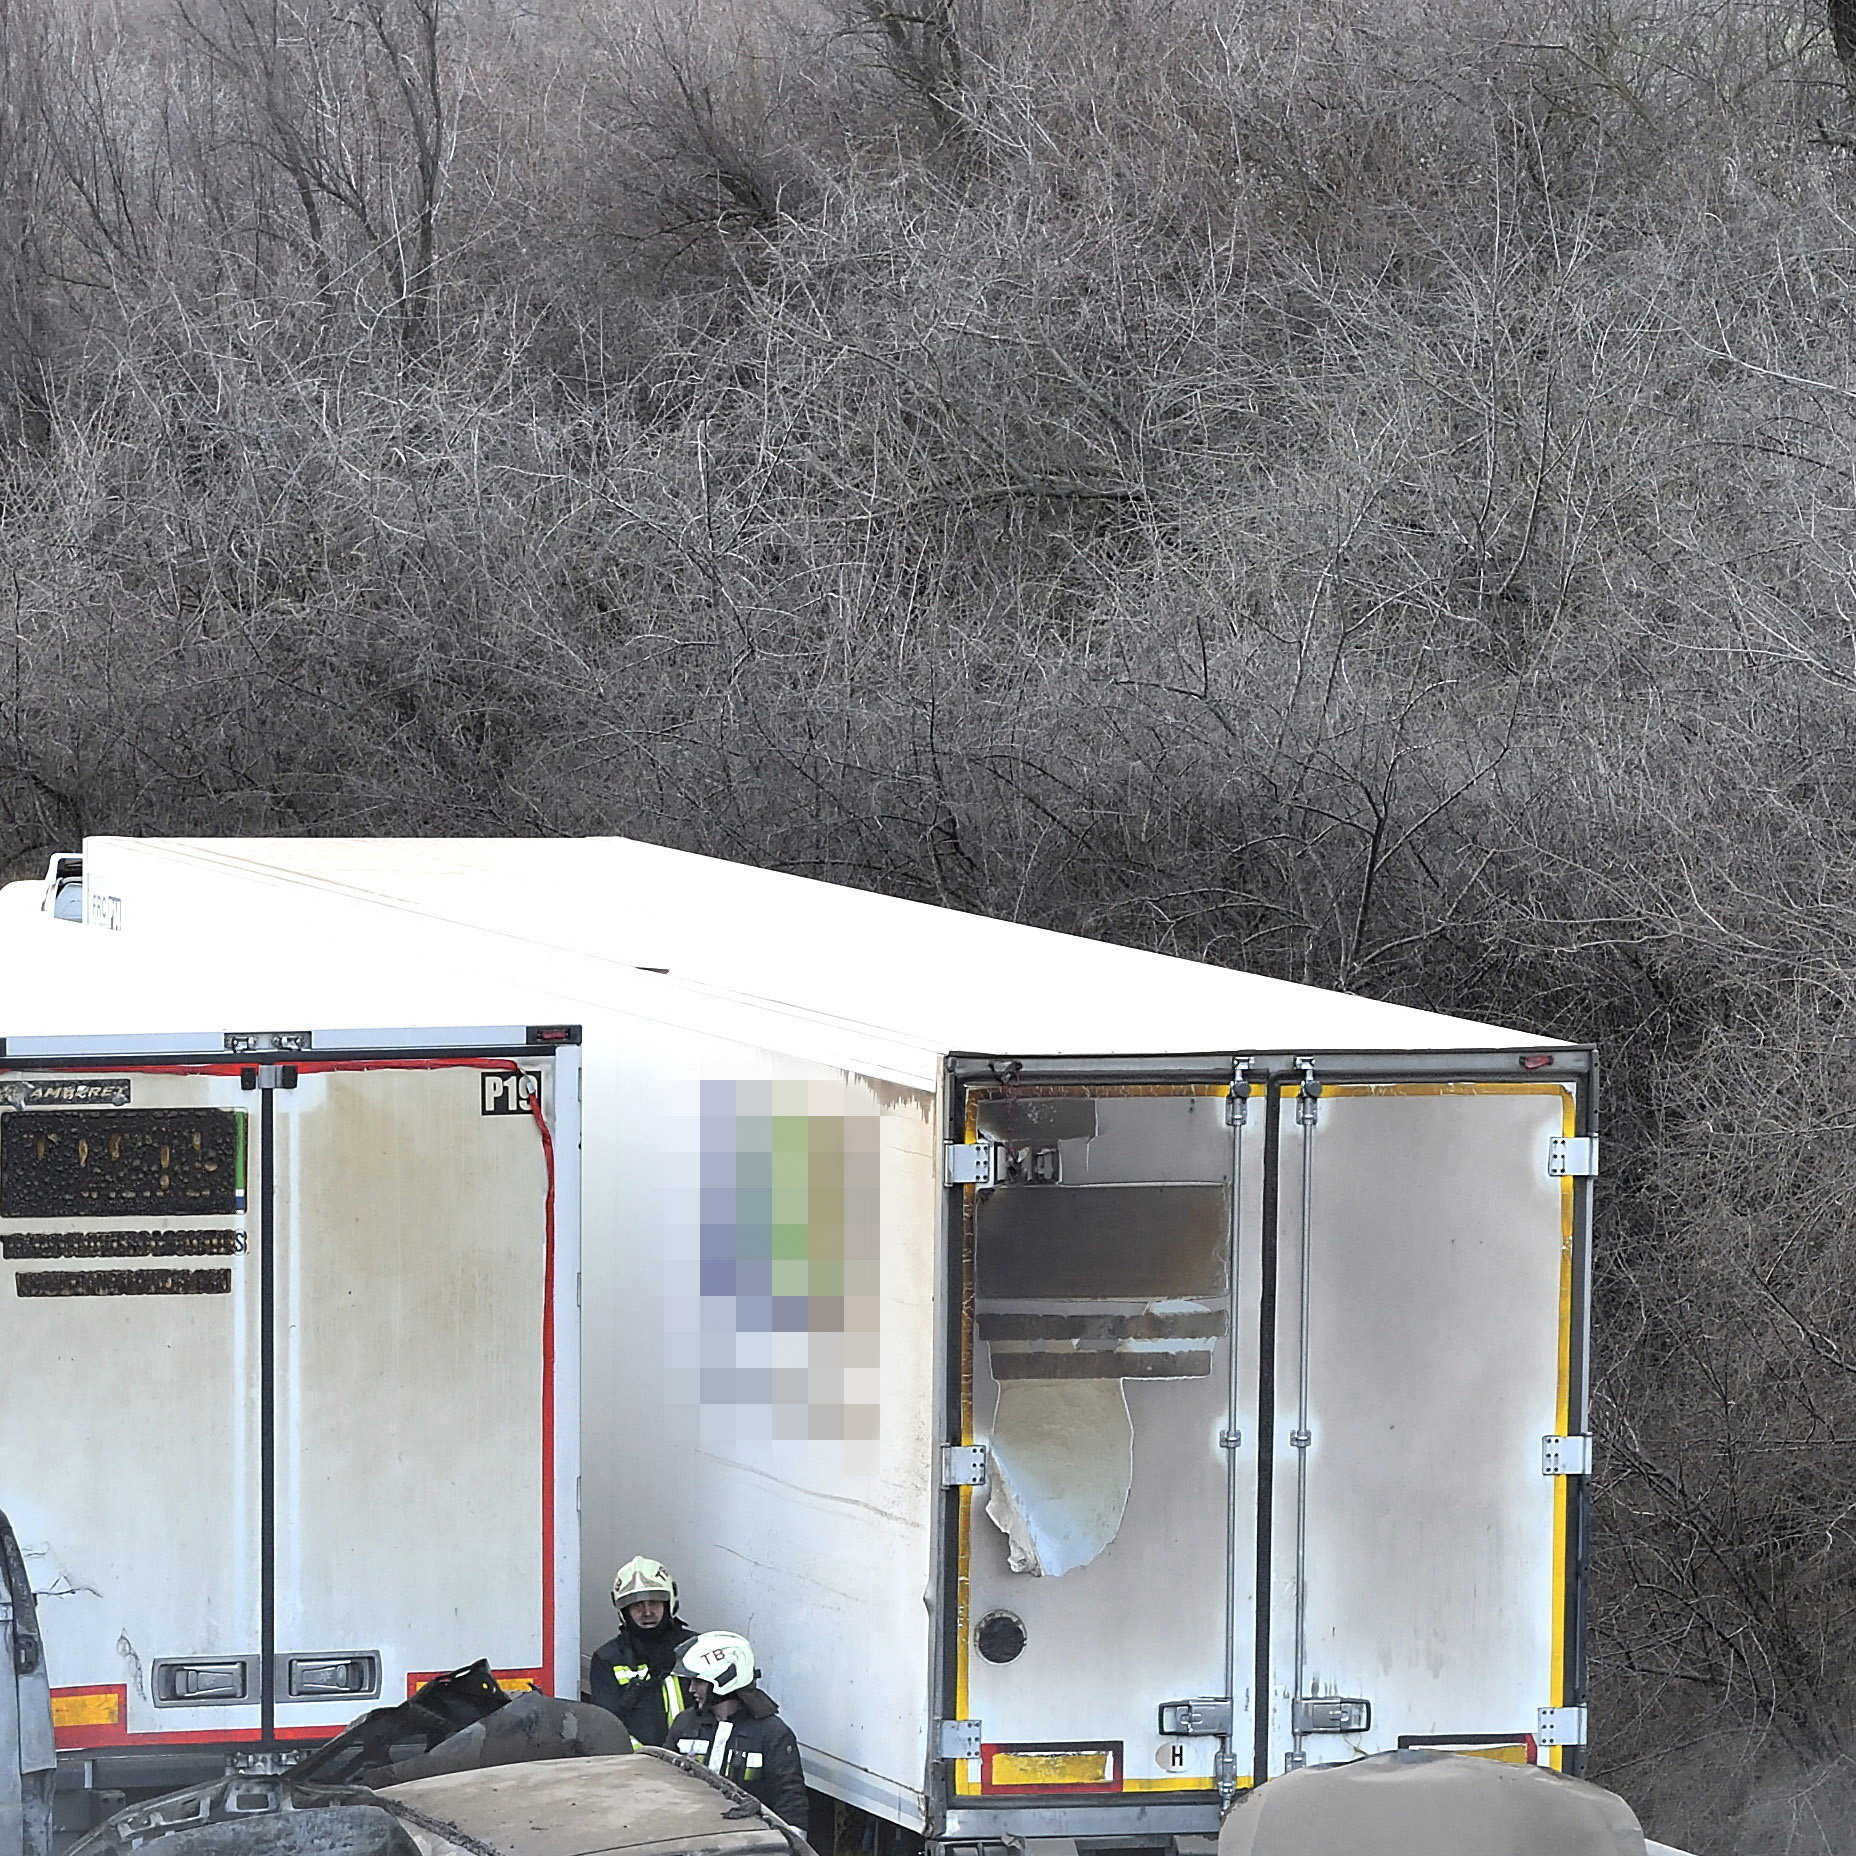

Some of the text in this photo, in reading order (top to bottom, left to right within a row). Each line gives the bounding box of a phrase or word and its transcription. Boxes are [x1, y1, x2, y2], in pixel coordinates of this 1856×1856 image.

[485, 1075, 539, 1112] P19
[700, 1648, 726, 1666] TB
[1171, 1745, 1184, 1767] H
